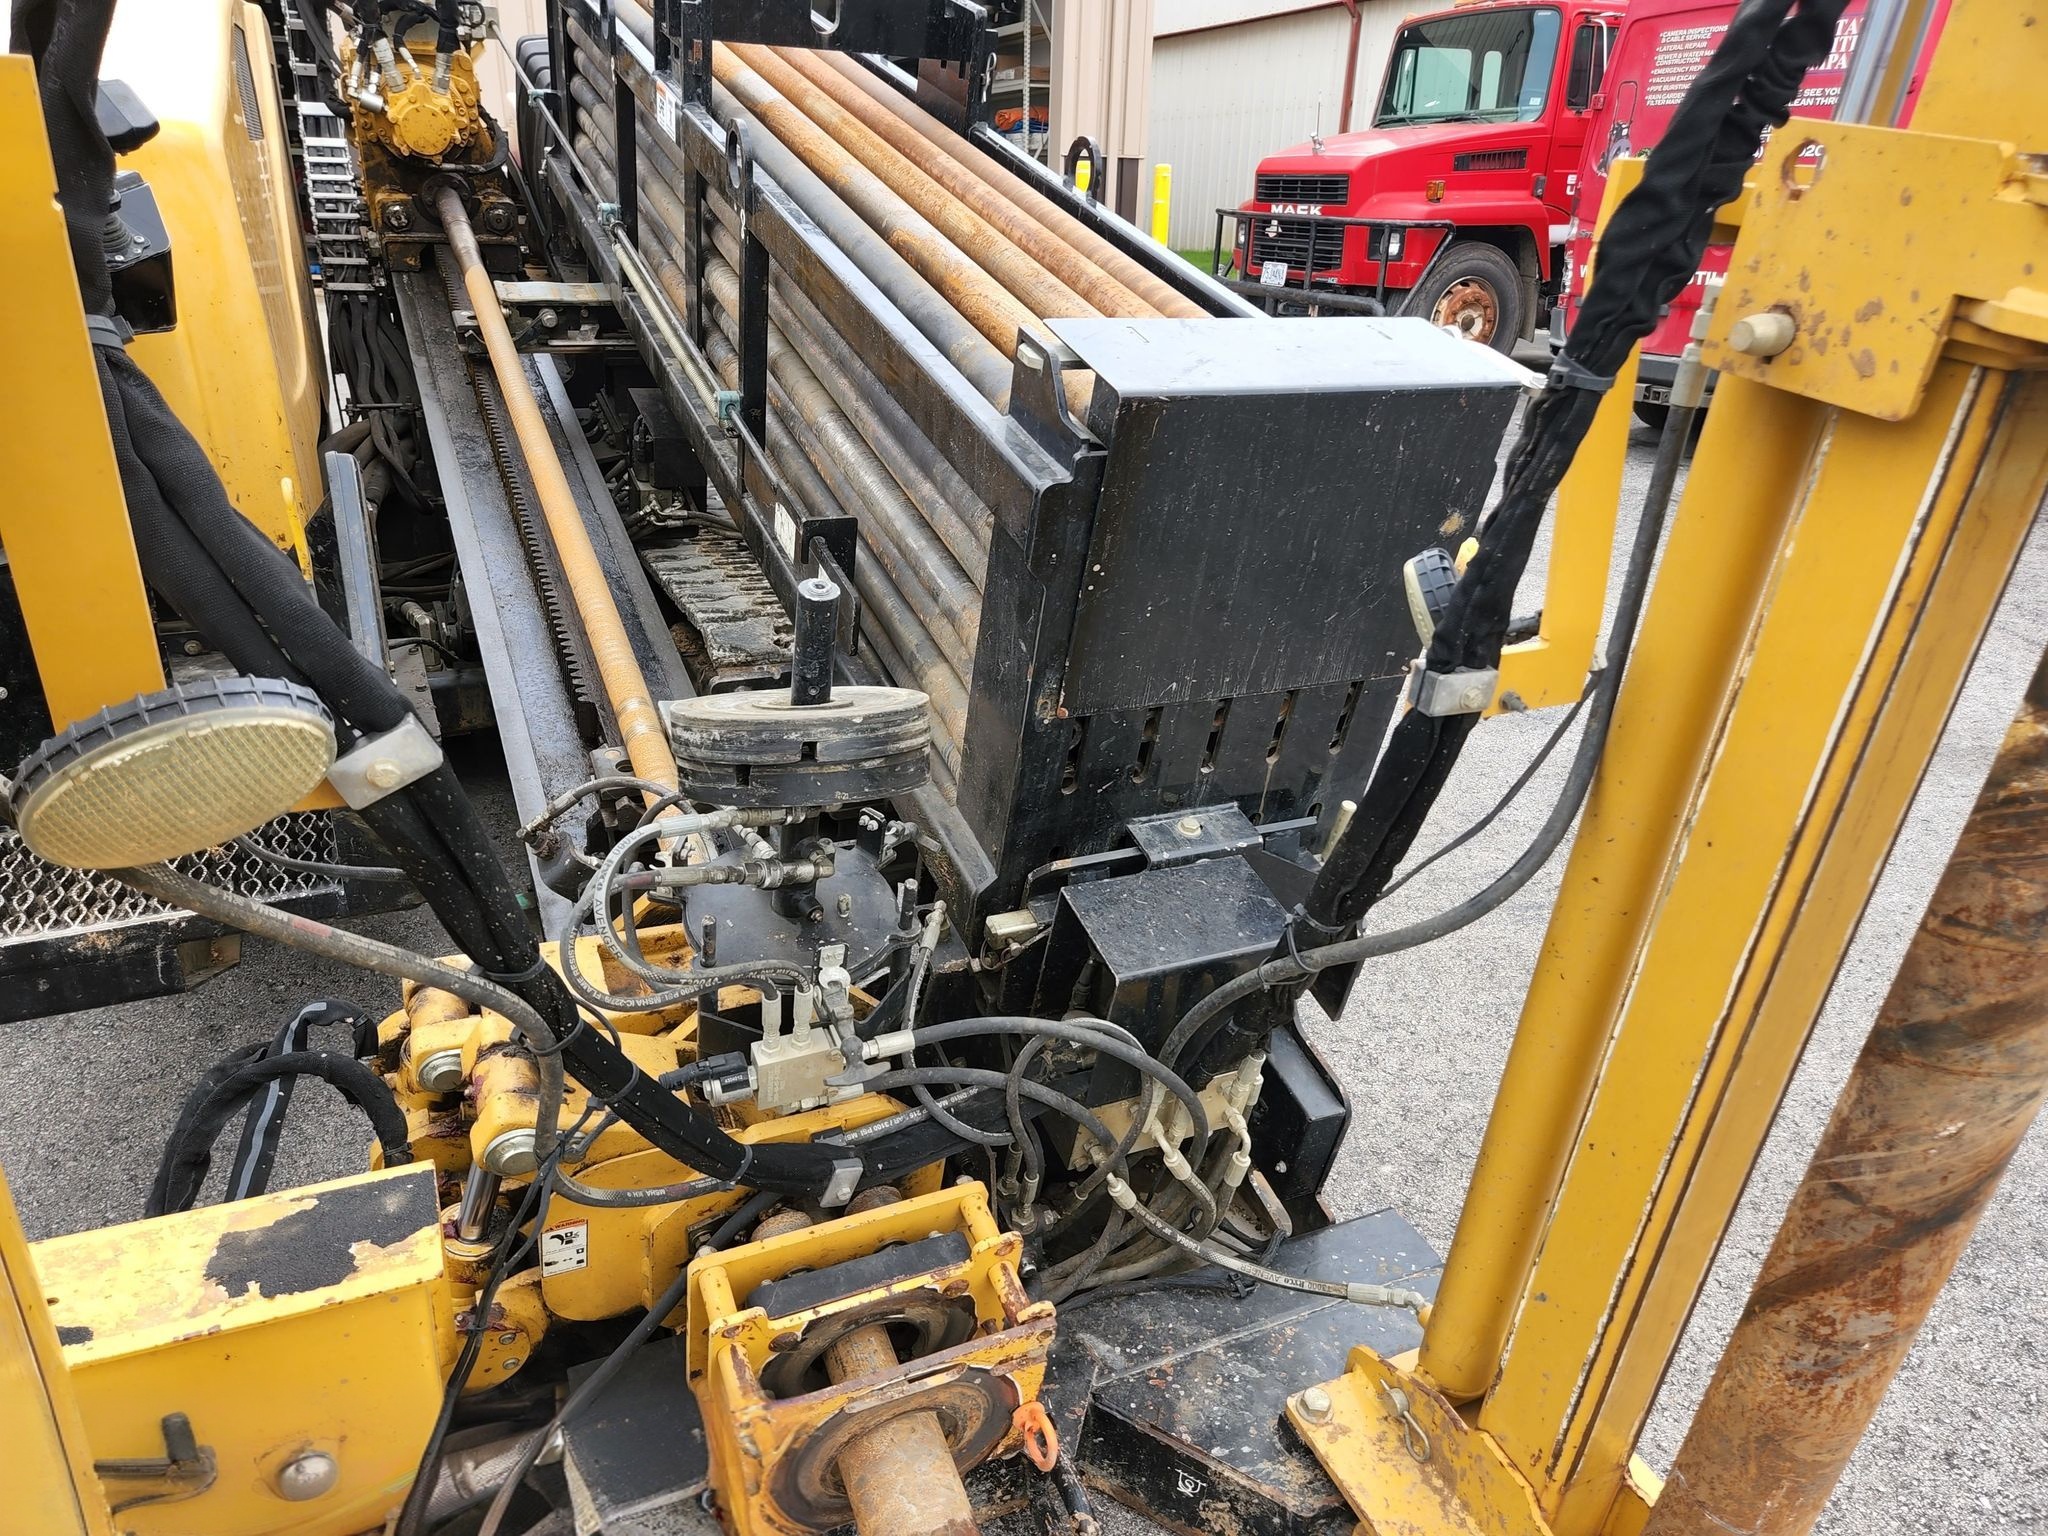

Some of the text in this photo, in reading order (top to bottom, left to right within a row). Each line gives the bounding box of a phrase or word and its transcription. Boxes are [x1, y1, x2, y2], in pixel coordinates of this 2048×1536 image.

[1662, 24, 1729, 38] CAMERA INSPECTIONS
[1686, 32, 1712, 41] SERVICE
[1659, 41, 1708, 52] LATERAL REPAIR
[1656, 52, 1678, 61] SEWER
[1683, 50, 1705, 59] WATER
[1655, 57, 1701, 67] CONSTRUCTION
[1653, 67, 1689, 75] EMERGENCY
[1652, 75, 1677, 83] VACUUM
[1803, 88, 1822, 97] SEE
[1271, 204, 1322, 216] MACK
[594, 898, 624, 960] AVENGER
[567, 926, 582, 977] RESISTANT
[576, 976, 601, 1000] FLAME
[635, 996, 662, 1008] MSHA
[860, 1125, 874, 1137] PSI
[1240, 1263, 1281, 1282] AVENGER
